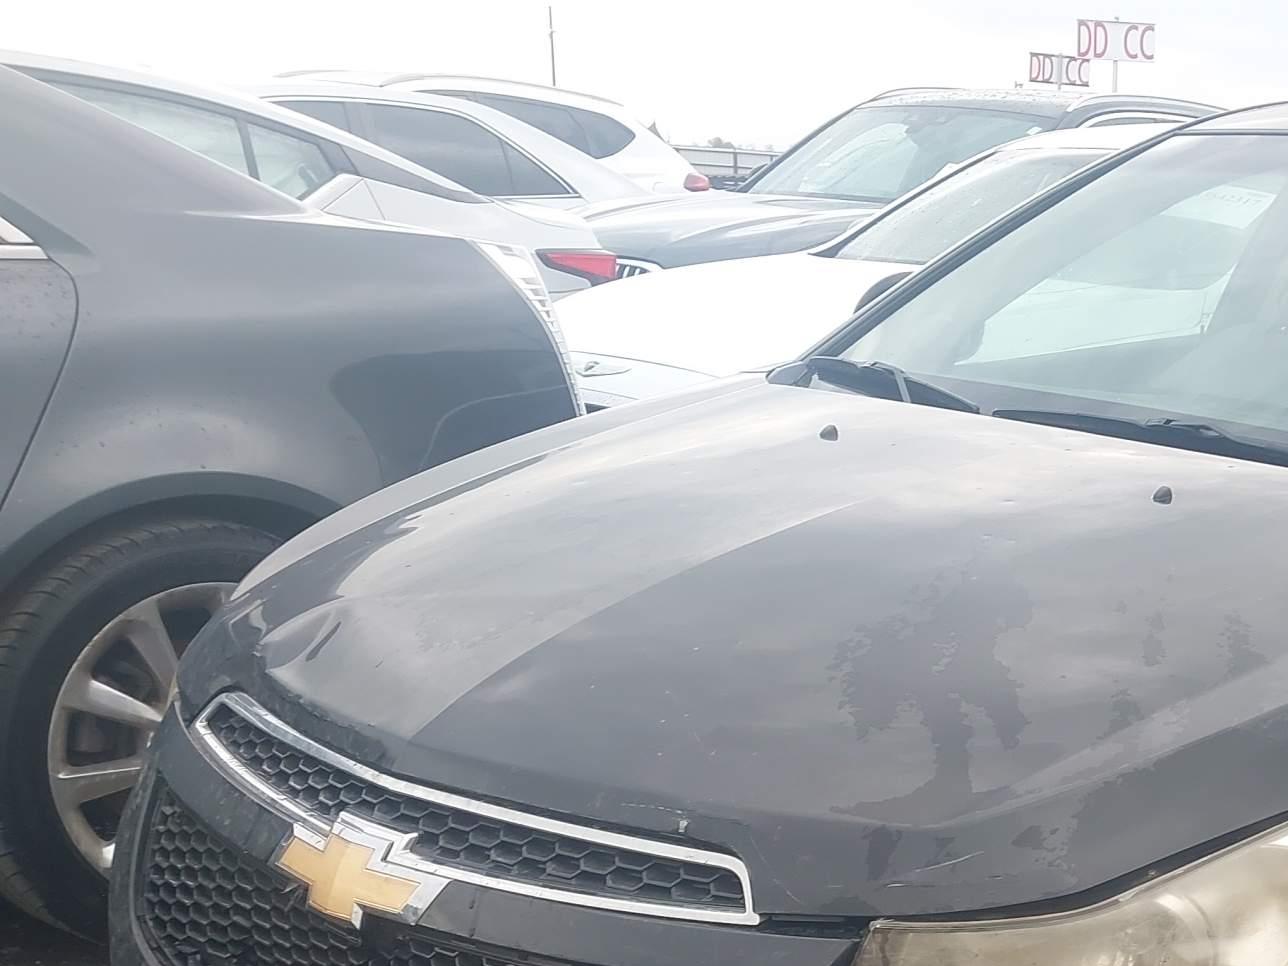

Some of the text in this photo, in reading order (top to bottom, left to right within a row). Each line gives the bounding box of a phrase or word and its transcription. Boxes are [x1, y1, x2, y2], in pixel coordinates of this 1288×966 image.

[1077, 20, 1156, 61] DD CC
[1030, 54, 1089, 84] DD CC
